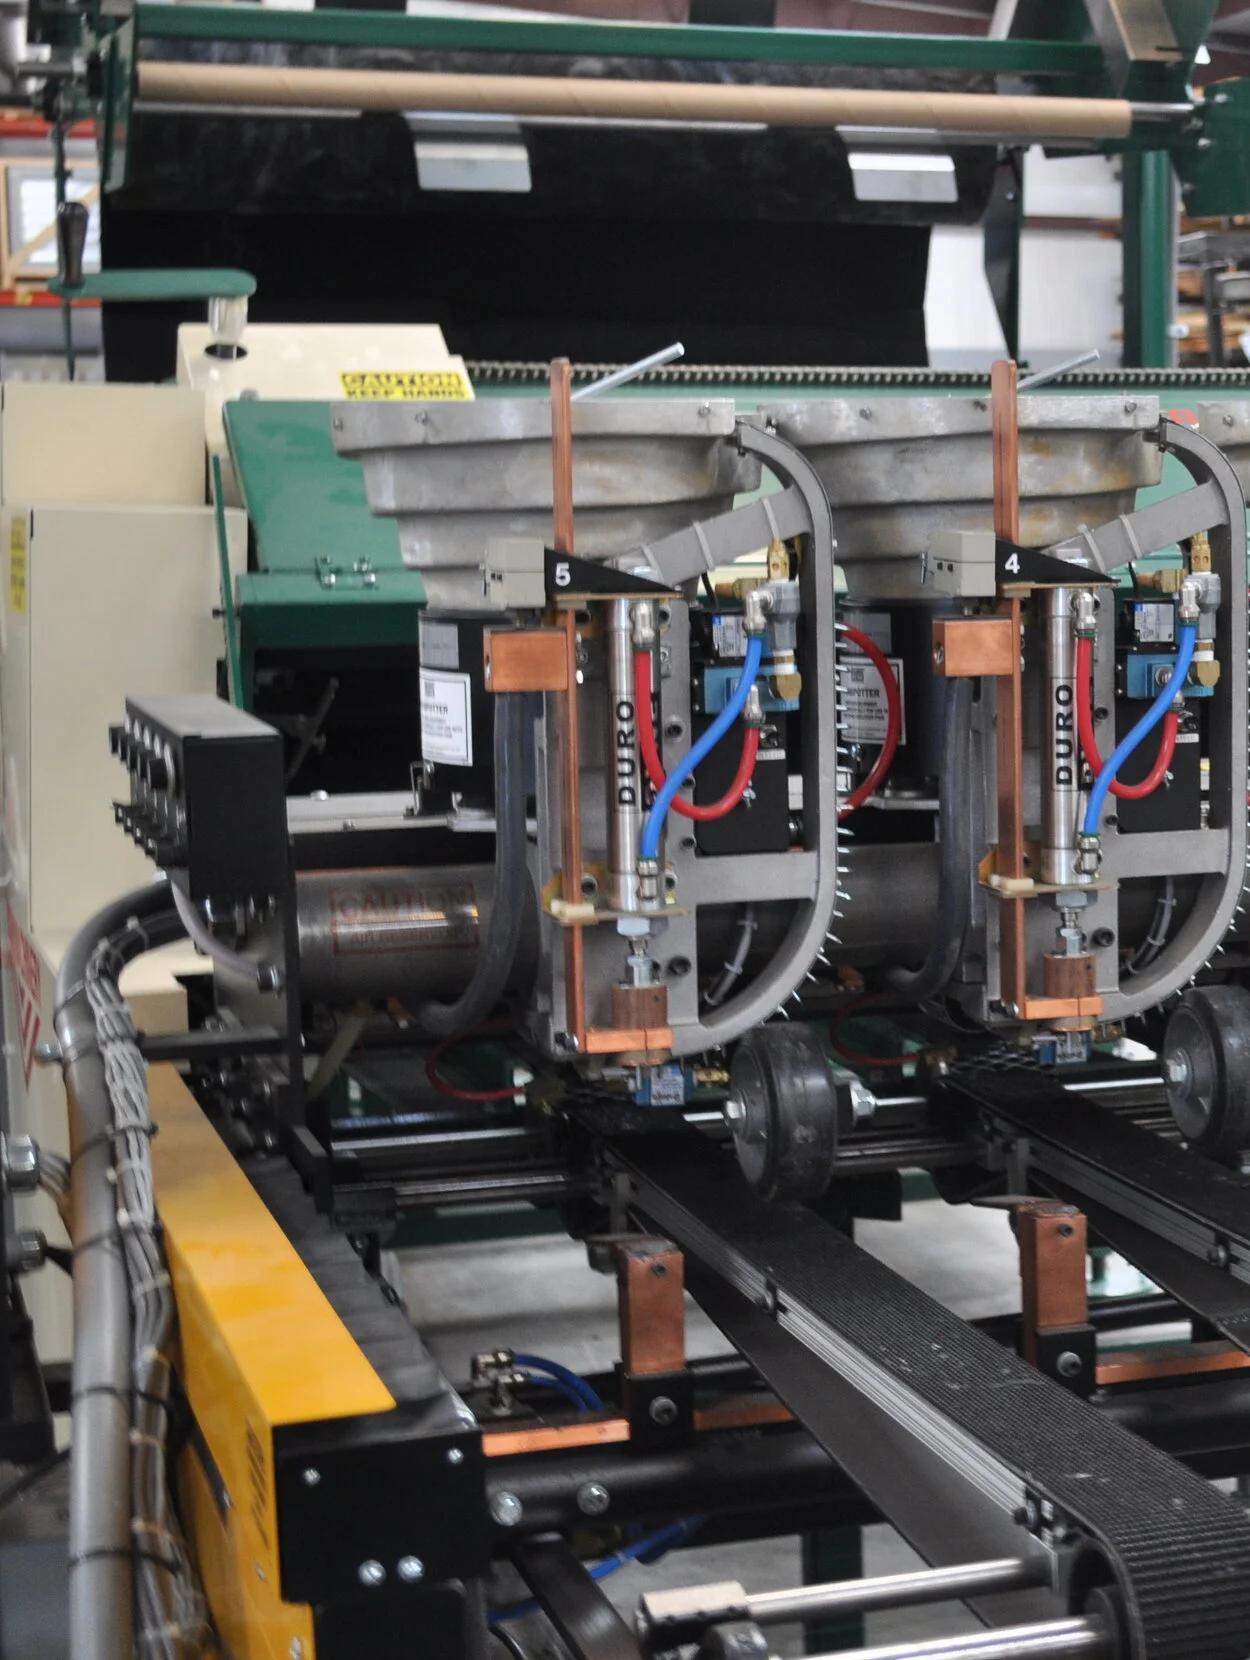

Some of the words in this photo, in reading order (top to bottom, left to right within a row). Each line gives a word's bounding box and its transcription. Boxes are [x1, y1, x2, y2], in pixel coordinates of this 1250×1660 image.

[555, 561, 571, 587] 5
[1005, 553, 1020, 574] 4
[616, 701, 636, 806] DURO
[1055, 684, 1073, 786] DURO
